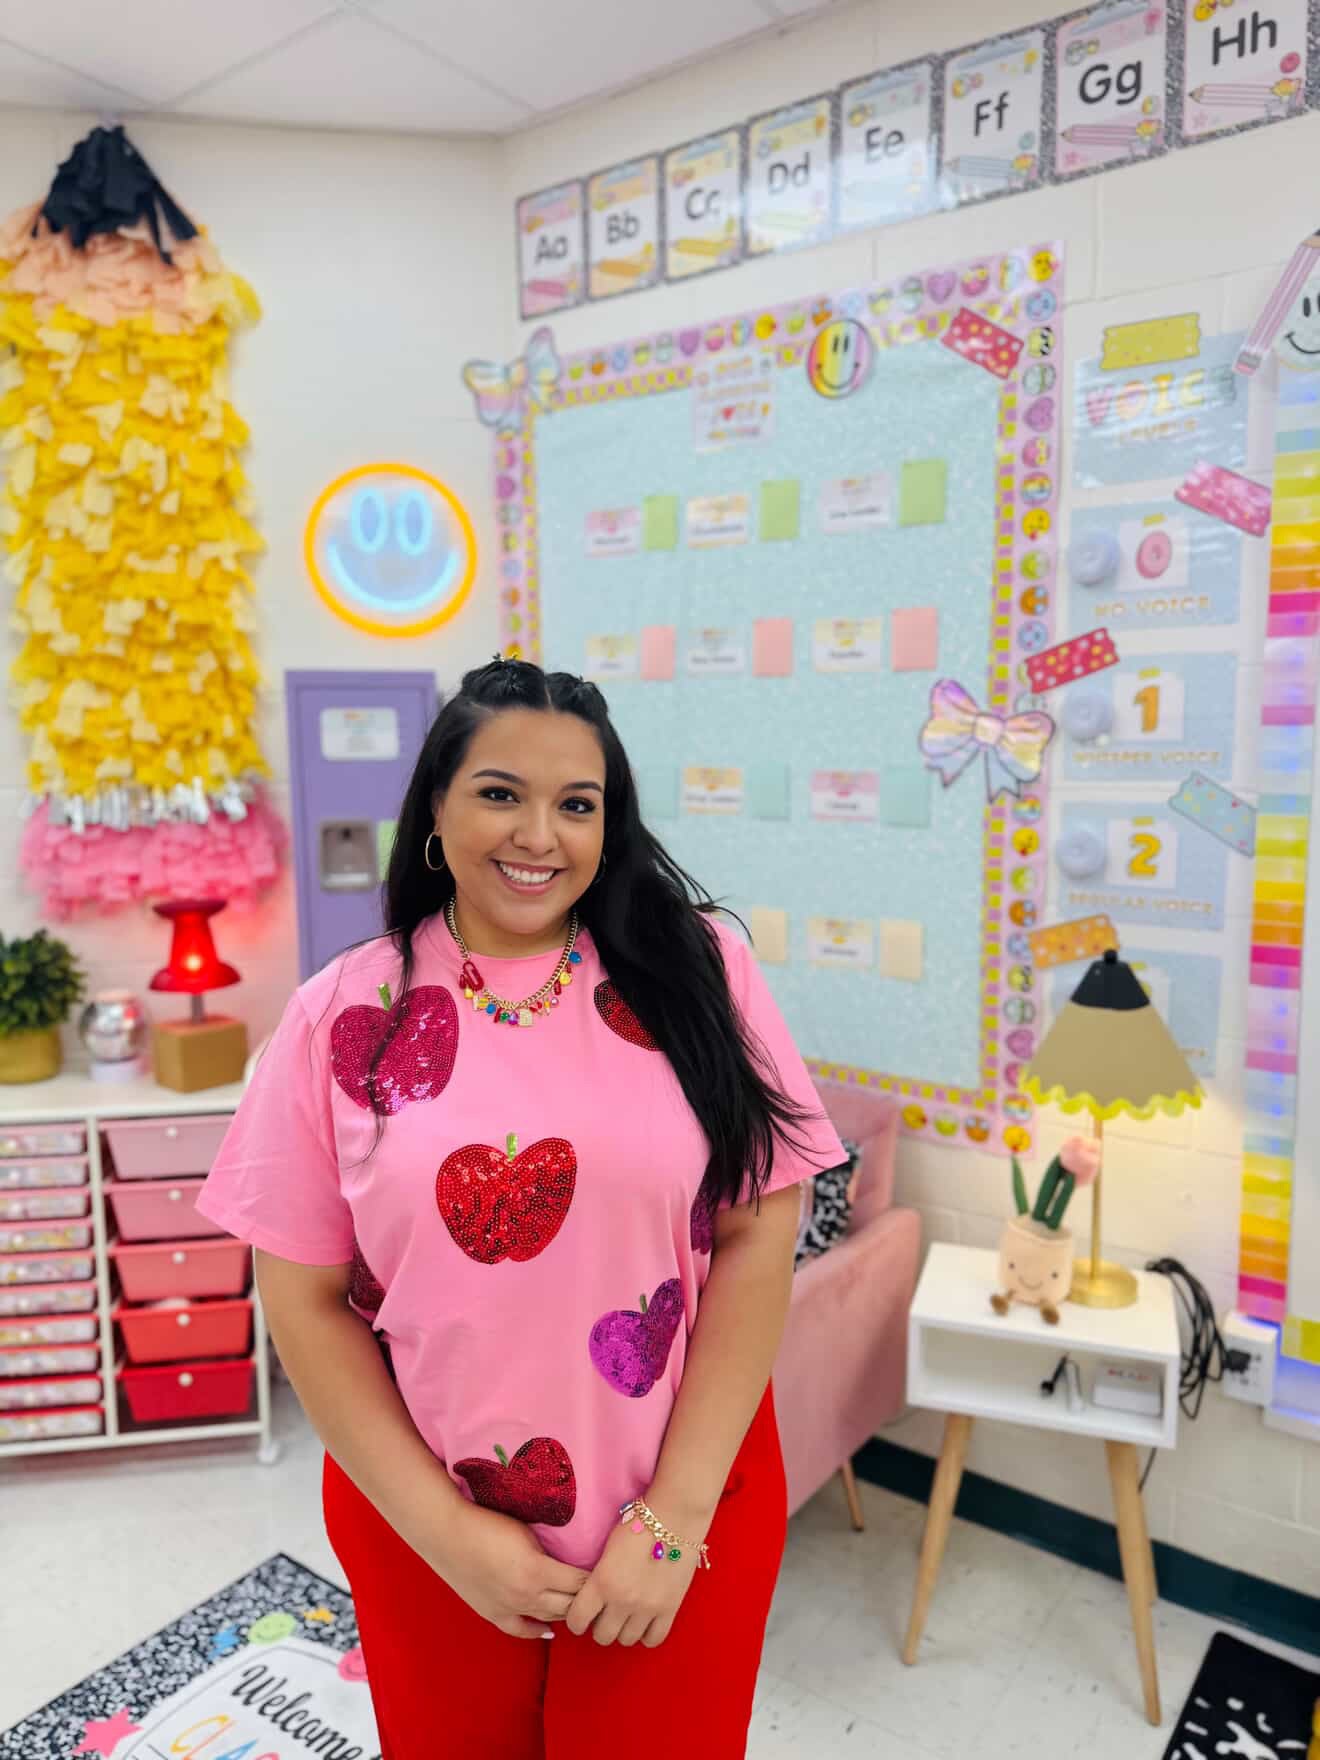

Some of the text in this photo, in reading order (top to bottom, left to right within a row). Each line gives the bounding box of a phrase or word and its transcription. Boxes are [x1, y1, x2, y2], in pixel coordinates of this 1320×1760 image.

[1211, 10, 1278, 65] Hh
[1077, 60, 1143, 107] Gg
[973, 92, 1010, 137] Ff
[864, 126, 905, 164] Ee
[767, 153, 811, 195] Dd
[684, 187, 721, 221] Cc
[534, 235, 568, 264] Aa
[606, 212, 640, 244] Bb
[1133, 685, 1160, 733] 1
[1128, 833, 1162, 878] 2
